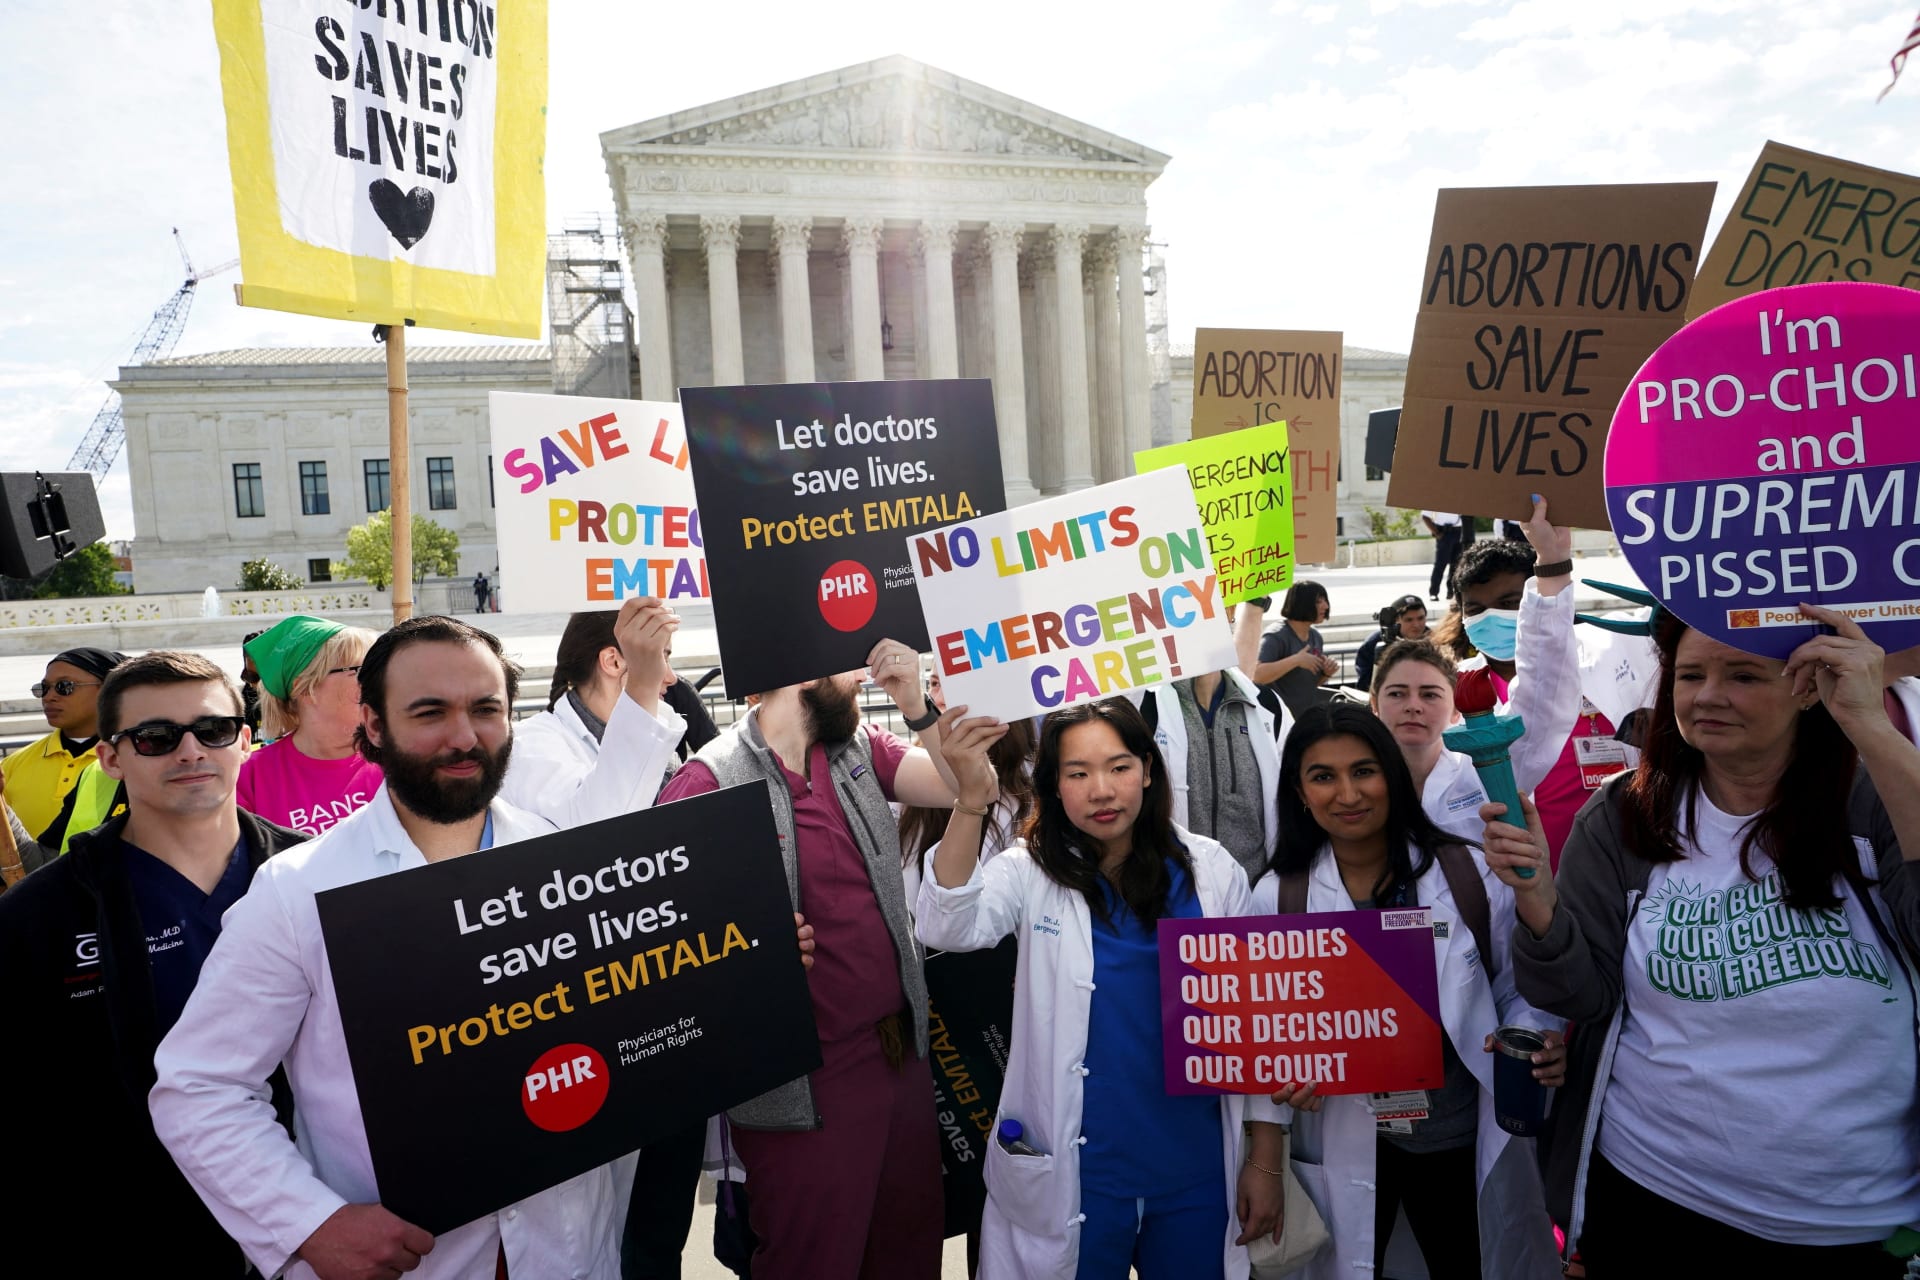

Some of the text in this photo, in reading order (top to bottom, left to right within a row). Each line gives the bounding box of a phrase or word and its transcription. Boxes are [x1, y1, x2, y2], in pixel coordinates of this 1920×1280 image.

[315, 15, 466, 120] SAVES
[331, 95, 457, 184] LIVES
[1741, 162, 1920, 265] EMERG
[1426, 241, 1692, 313] ABORTIONS
[1758, 308, 1842, 355] I'm
[1200, 350, 1337, 400] ABORTION
[1466, 324, 1604, 396] SAVE
[503, 412, 630, 494] SAVE
[776, 413, 938, 451] Let doctors
[1438, 406, 1592, 477] LIVES
[1756, 415, 1866, 472] and
[792, 456, 935, 496] save lives.
[741, 491, 982, 549] Protect EMTALA.
[915, 505, 1206, 579] NO LIMITS ON
[1206, 533, 1235, 556] IS
[885, 576, 915, 591] Human
[1213, 541, 1290, 575] ENTIAL
[1659, 545, 1858, 600] PISSED
[819, 572, 869, 601] PHR
[935, 574, 1217, 677] EMERGENCY
[1030, 635, 1183, 708] CARE!
[289, 792, 369, 829] BANS
[453, 845, 690, 936] Let doctors
[1667, 892, 1723, 927] OUR
[479, 900, 688, 985] save lives.
[1178, 927, 1348, 964] OUR BODIES
[1658, 924, 1724, 961] OUR
[408, 922, 759, 1065] Protect EMTALA.
[1181, 970, 1325, 1004] OUR LIVES
[1647, 938, 1893, 1001] OUR FREEDOM
[617, 1016, 696, 1053] Physicians for
[620, 1027, 703, 1067] Human Rights
[1183, 1007, 1399, 1044] OUR DECISIONS
[525, 1055, 596, 1102] PHR
[1185, 1052, 1348, 1084] OUR COURT
[938, 1110, 976, 1163] save
